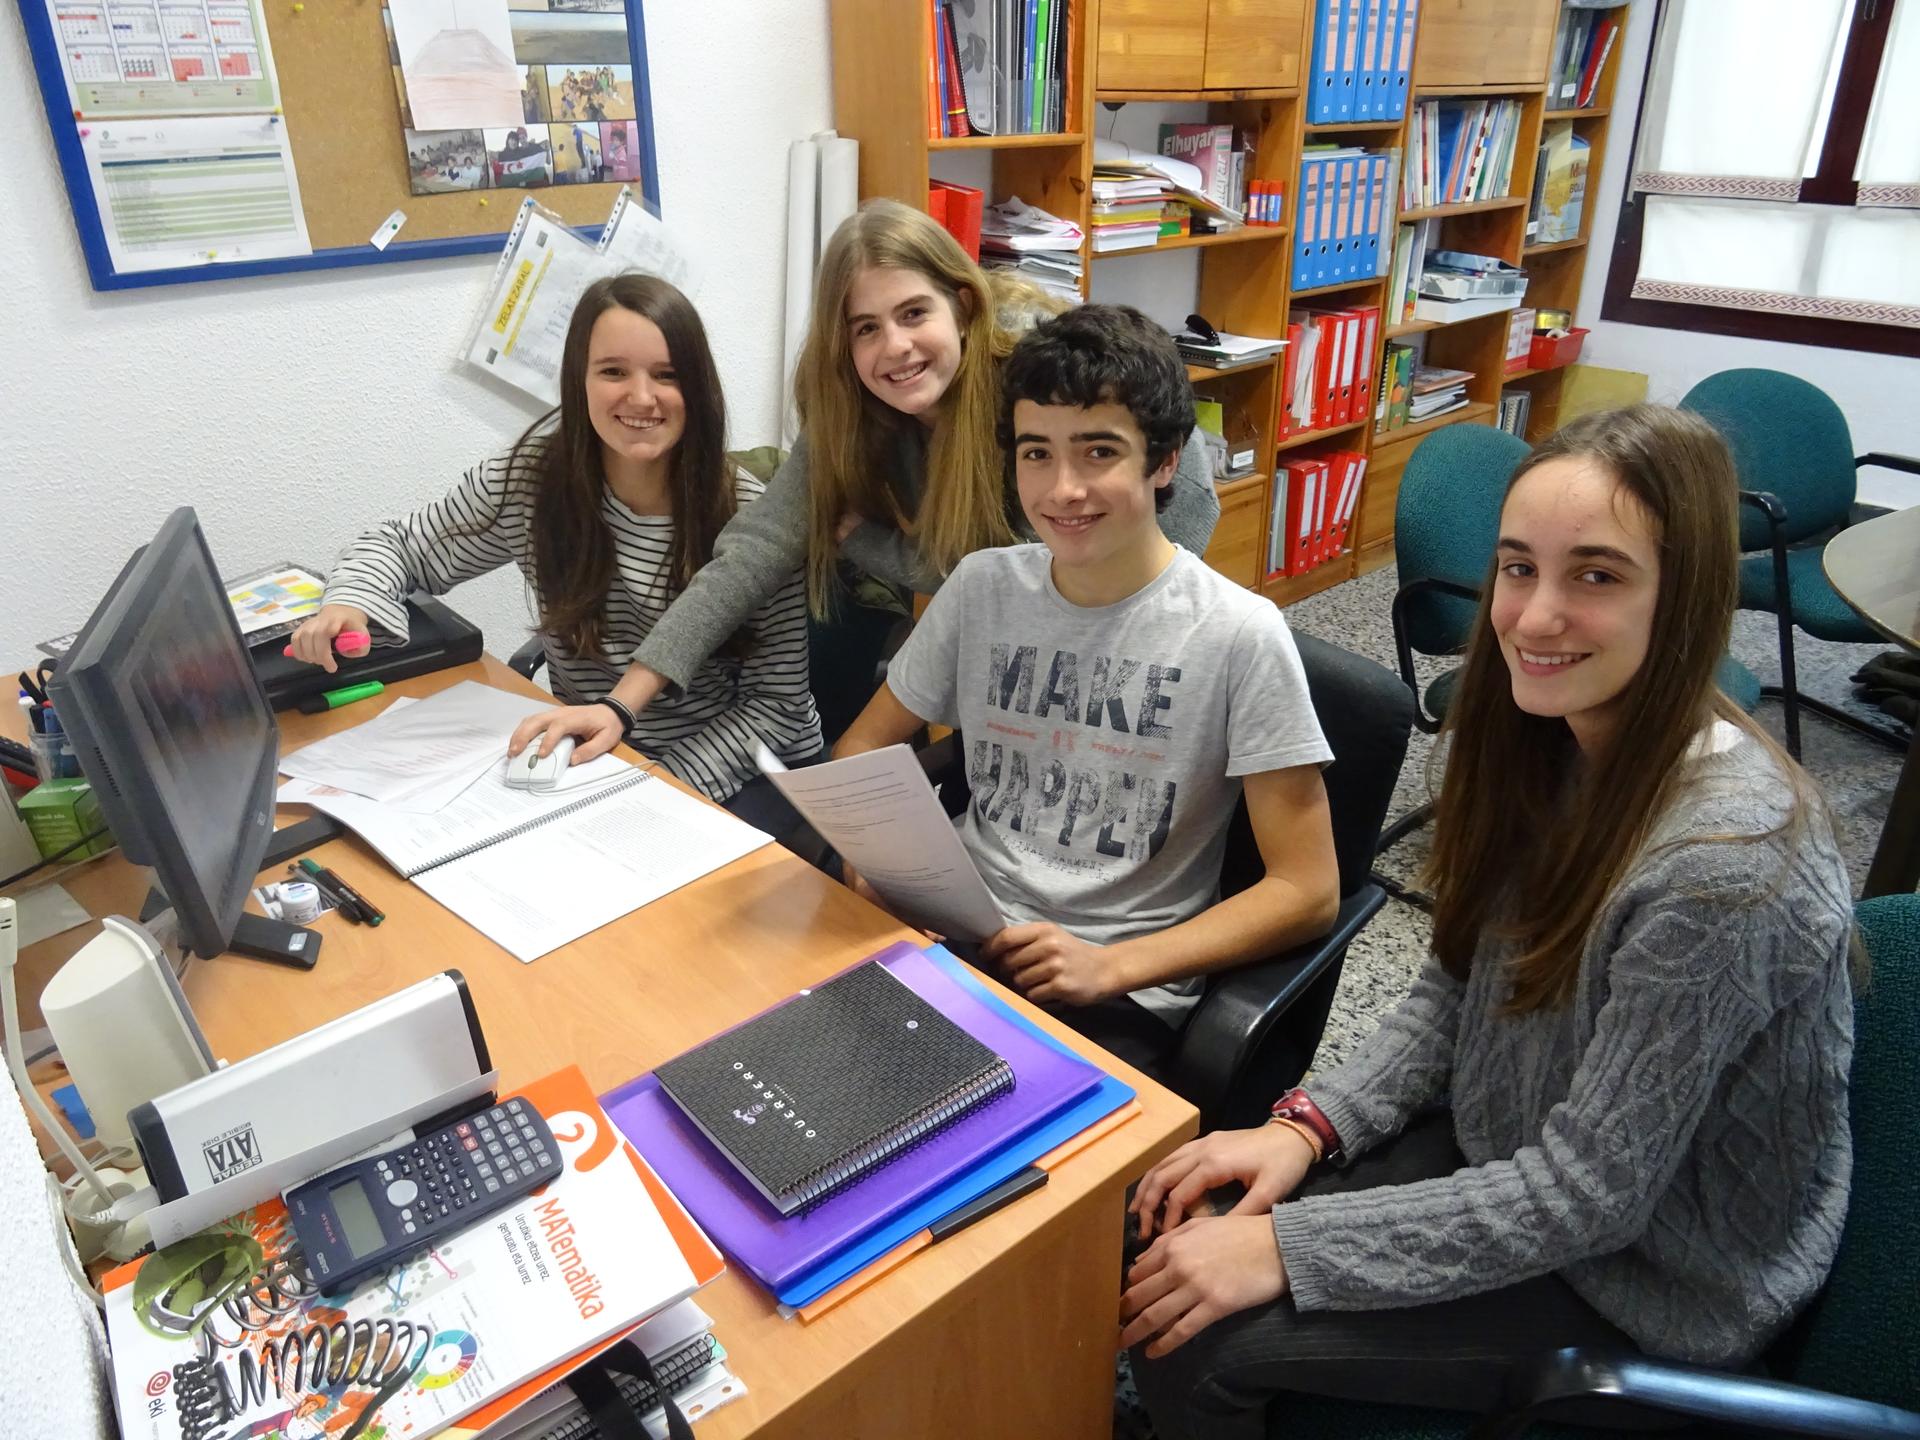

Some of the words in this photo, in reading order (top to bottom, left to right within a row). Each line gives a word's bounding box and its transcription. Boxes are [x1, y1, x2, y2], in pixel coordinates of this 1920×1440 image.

[1163, 130, 1214, 157] Elhuyar
[987, 643, 1182, 741] MAKE
[733, 1062, 816, 1138] GUERRERO
[200, 1136, 220, 1149] DISK
[207, 1131, 252, 1172] ATA
[214, 1155, 261, 1182] SERIAL
[515, 1213, 533, 1241] Urrutiko
[497, 1222, 517, 1254] gerturatu
[511, 1252, 523, 1265] eta
[315, 1252, 330, 1274] CASIO
[533, 1197, 605, 1320] MATematika
[148, 1398, 167, 1420] eki
